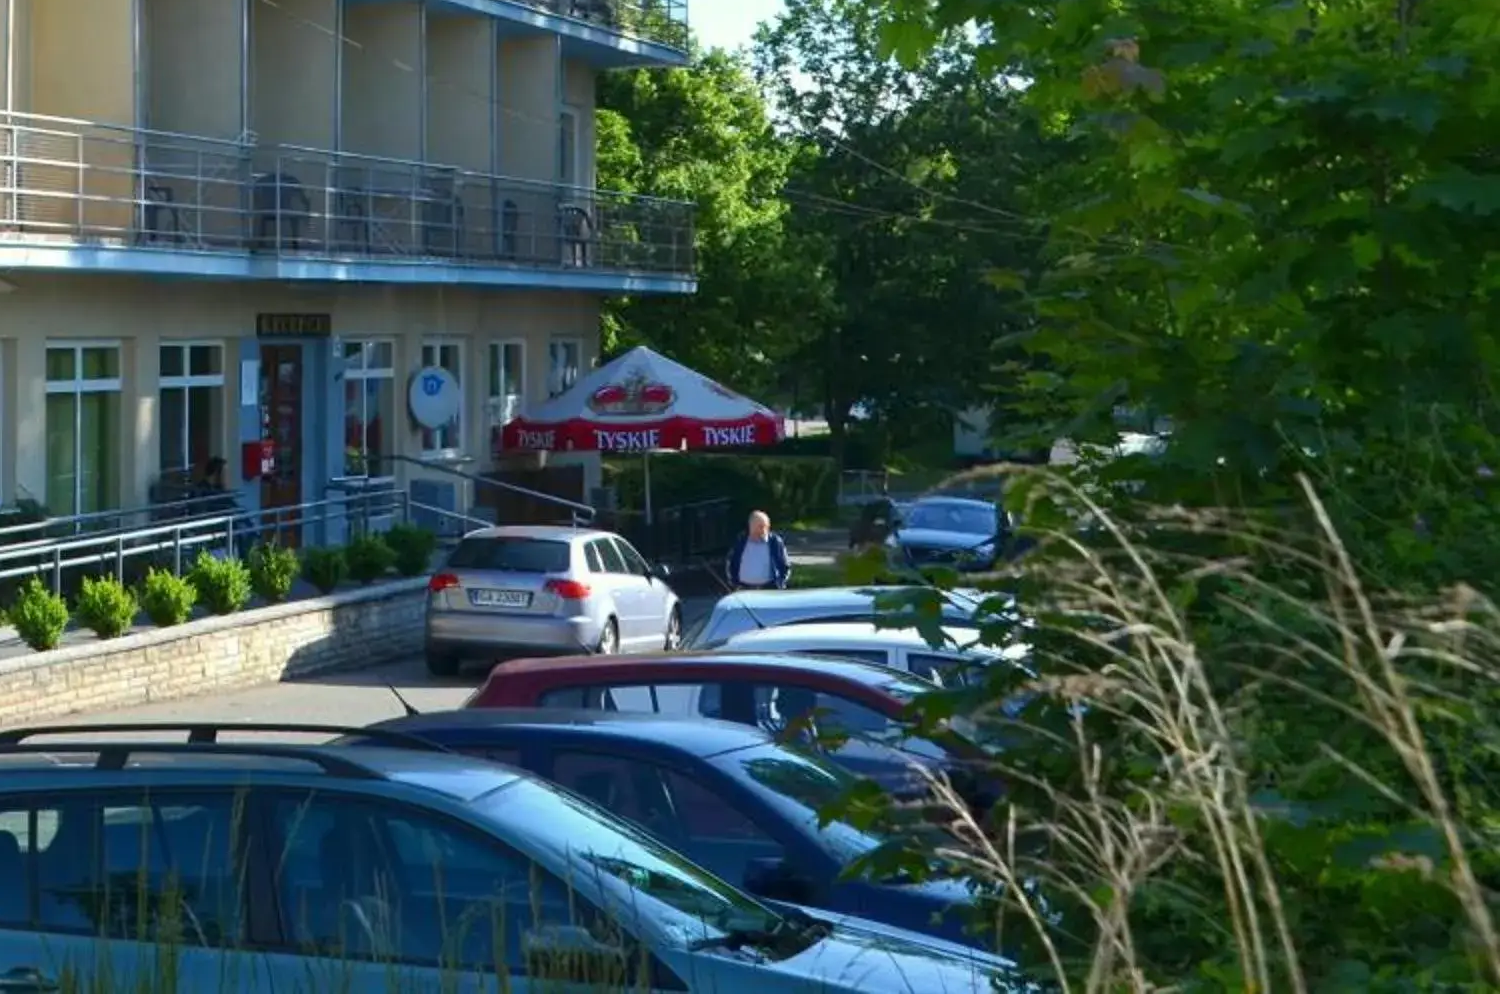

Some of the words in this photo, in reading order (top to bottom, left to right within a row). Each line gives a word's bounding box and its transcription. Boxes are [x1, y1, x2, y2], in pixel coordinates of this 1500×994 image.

[517, 429, 556, 448] TYSKIE
[593, 429, 660, 449] TYSKIE
[703, 424, 756, 446] TYSKIE
